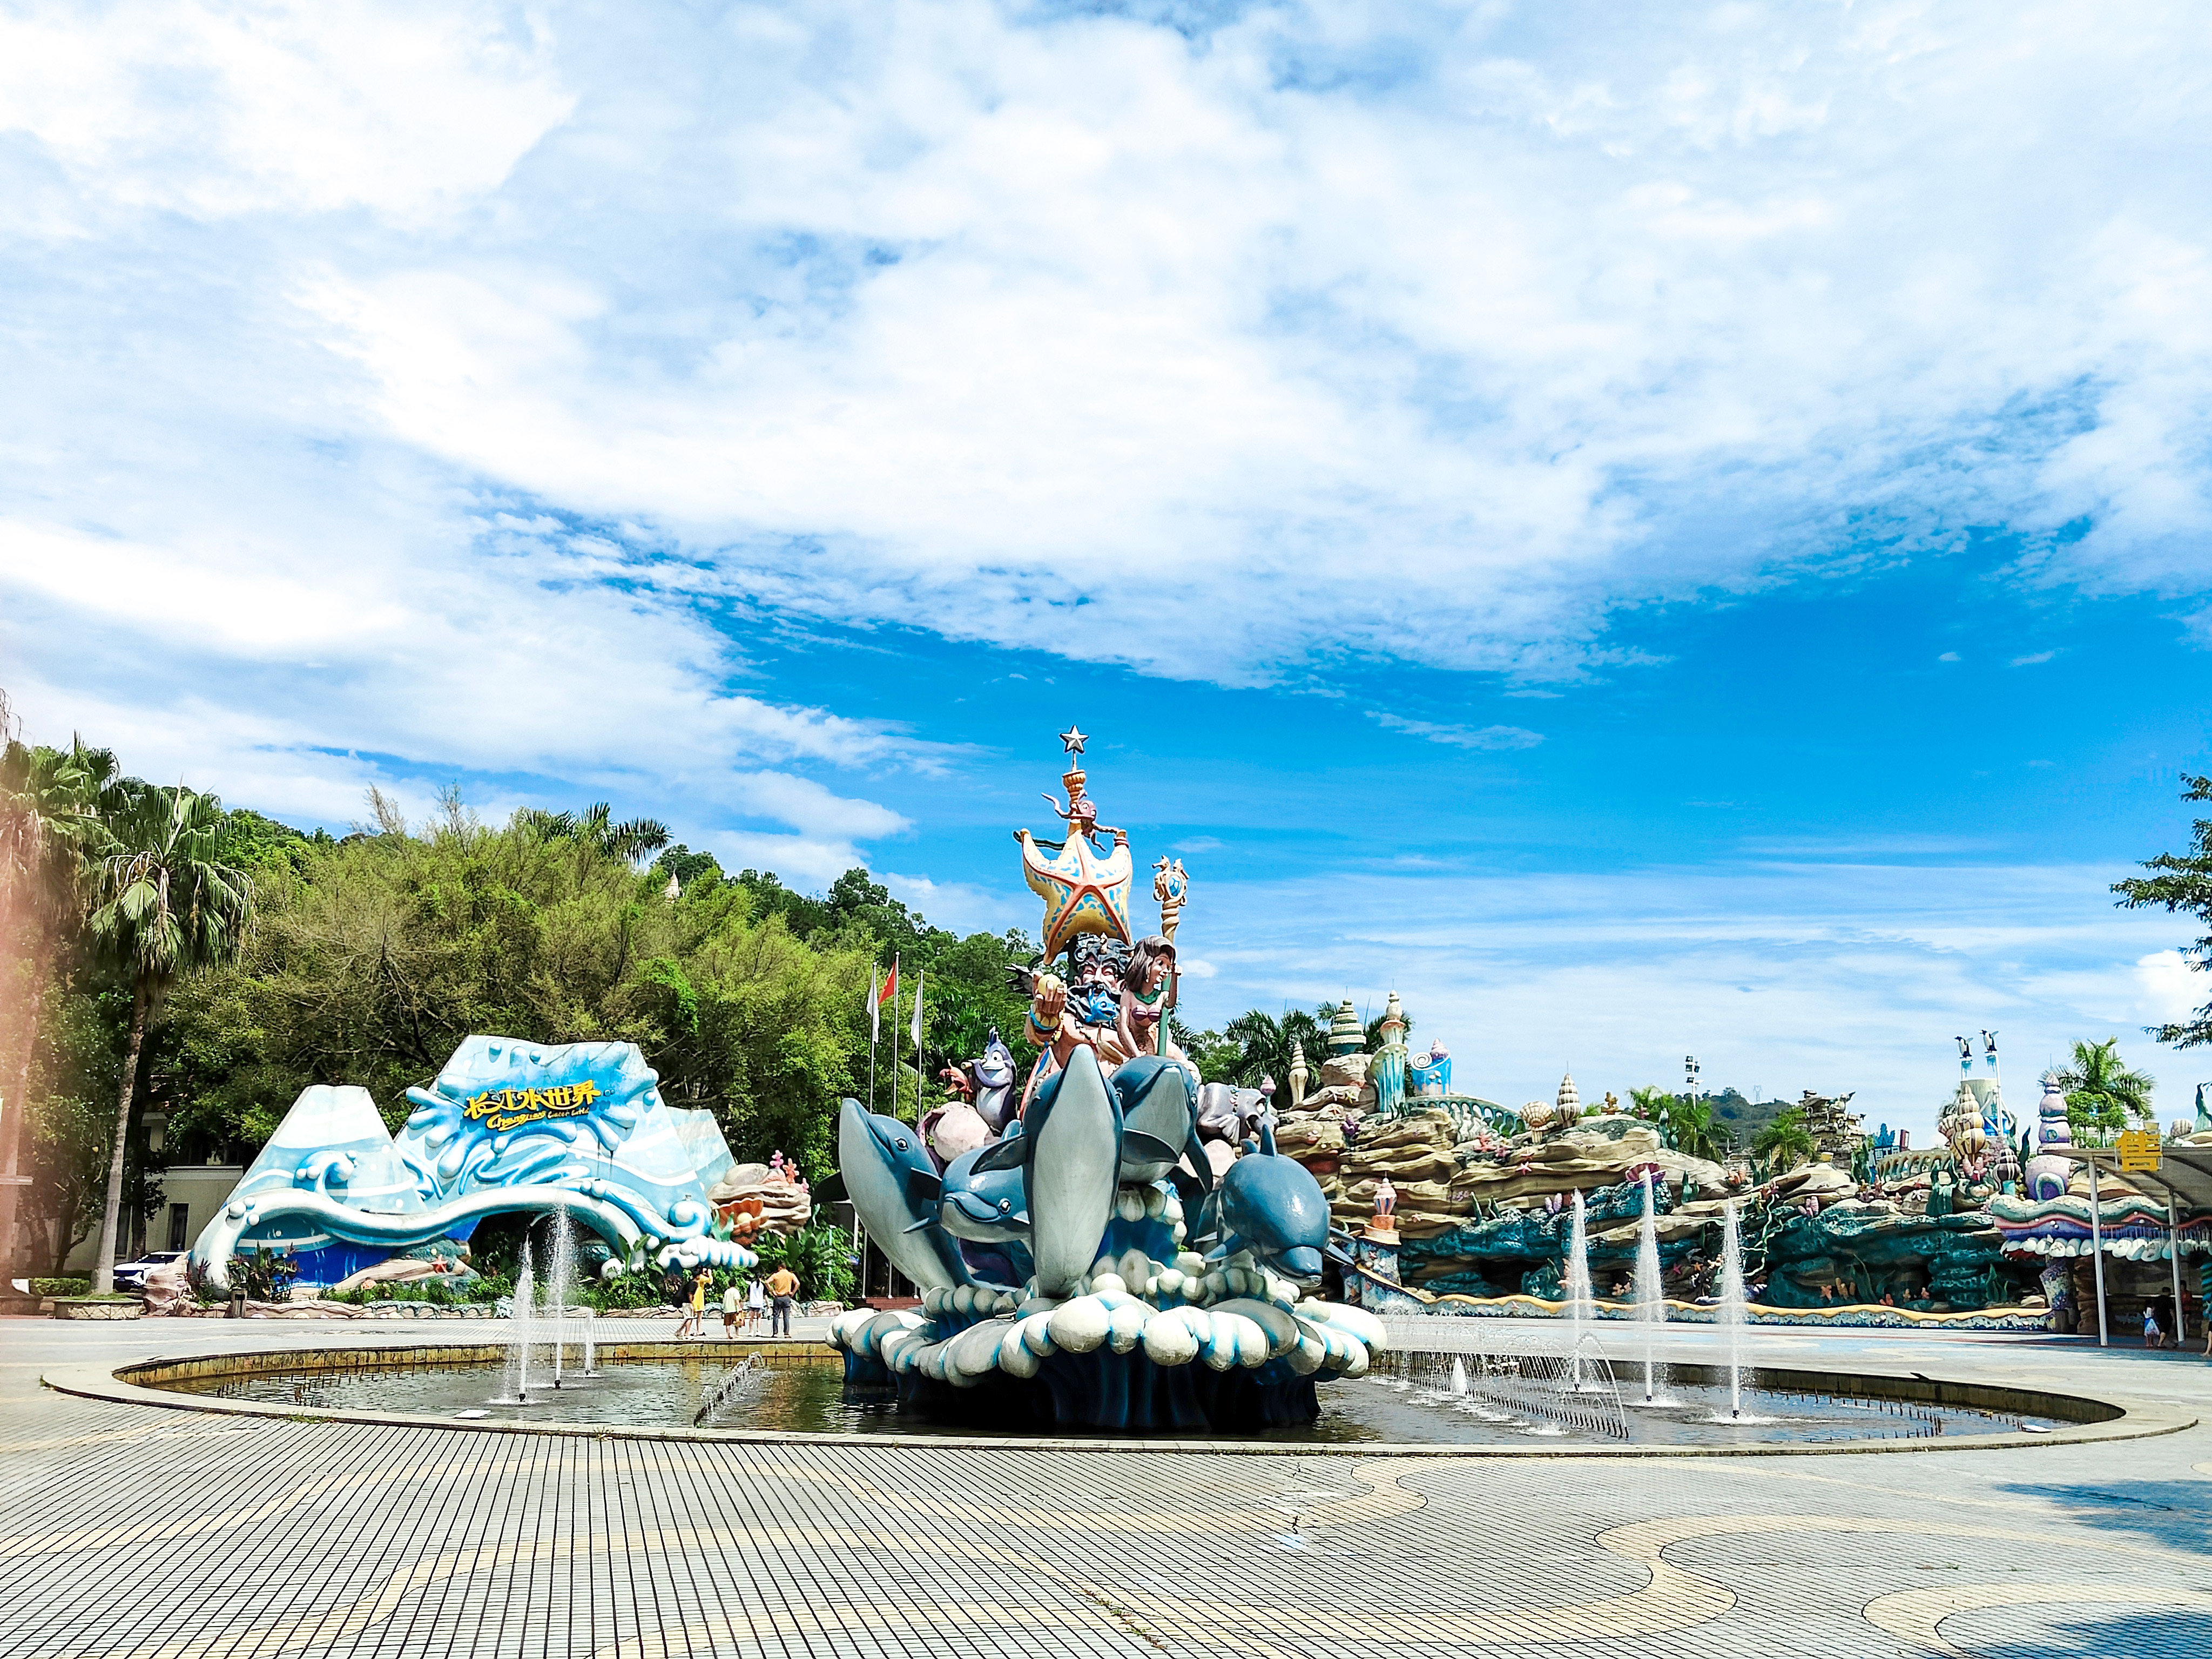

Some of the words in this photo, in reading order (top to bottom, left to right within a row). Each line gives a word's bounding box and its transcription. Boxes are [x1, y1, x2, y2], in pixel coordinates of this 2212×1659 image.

[464, 1079, 601, 1120] 长江水世界
